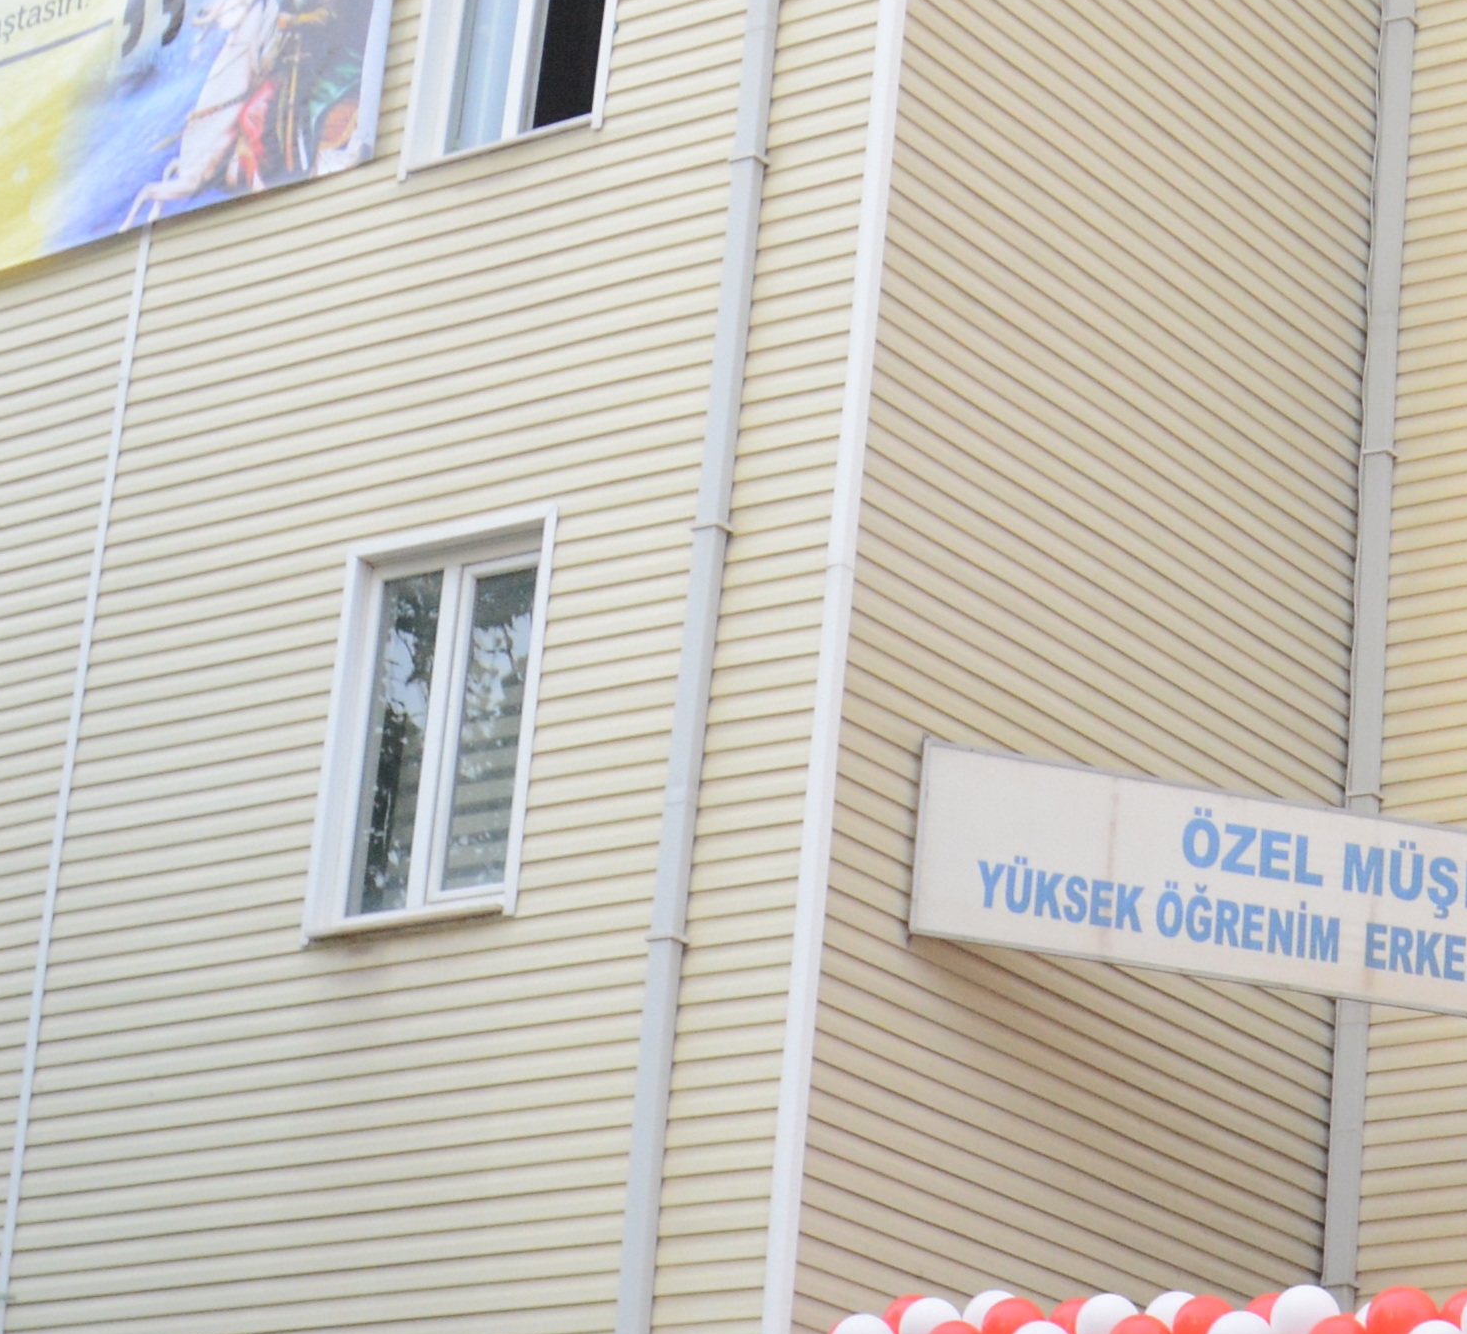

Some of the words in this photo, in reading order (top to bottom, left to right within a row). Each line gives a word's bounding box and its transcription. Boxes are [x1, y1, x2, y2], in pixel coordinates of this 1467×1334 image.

[1182, 806, 1323, 887] ÖZEL
[978, 855, 1144, 933] YÜKSEK
[1156, 880, 1340, 963] ÖĞRENİM
